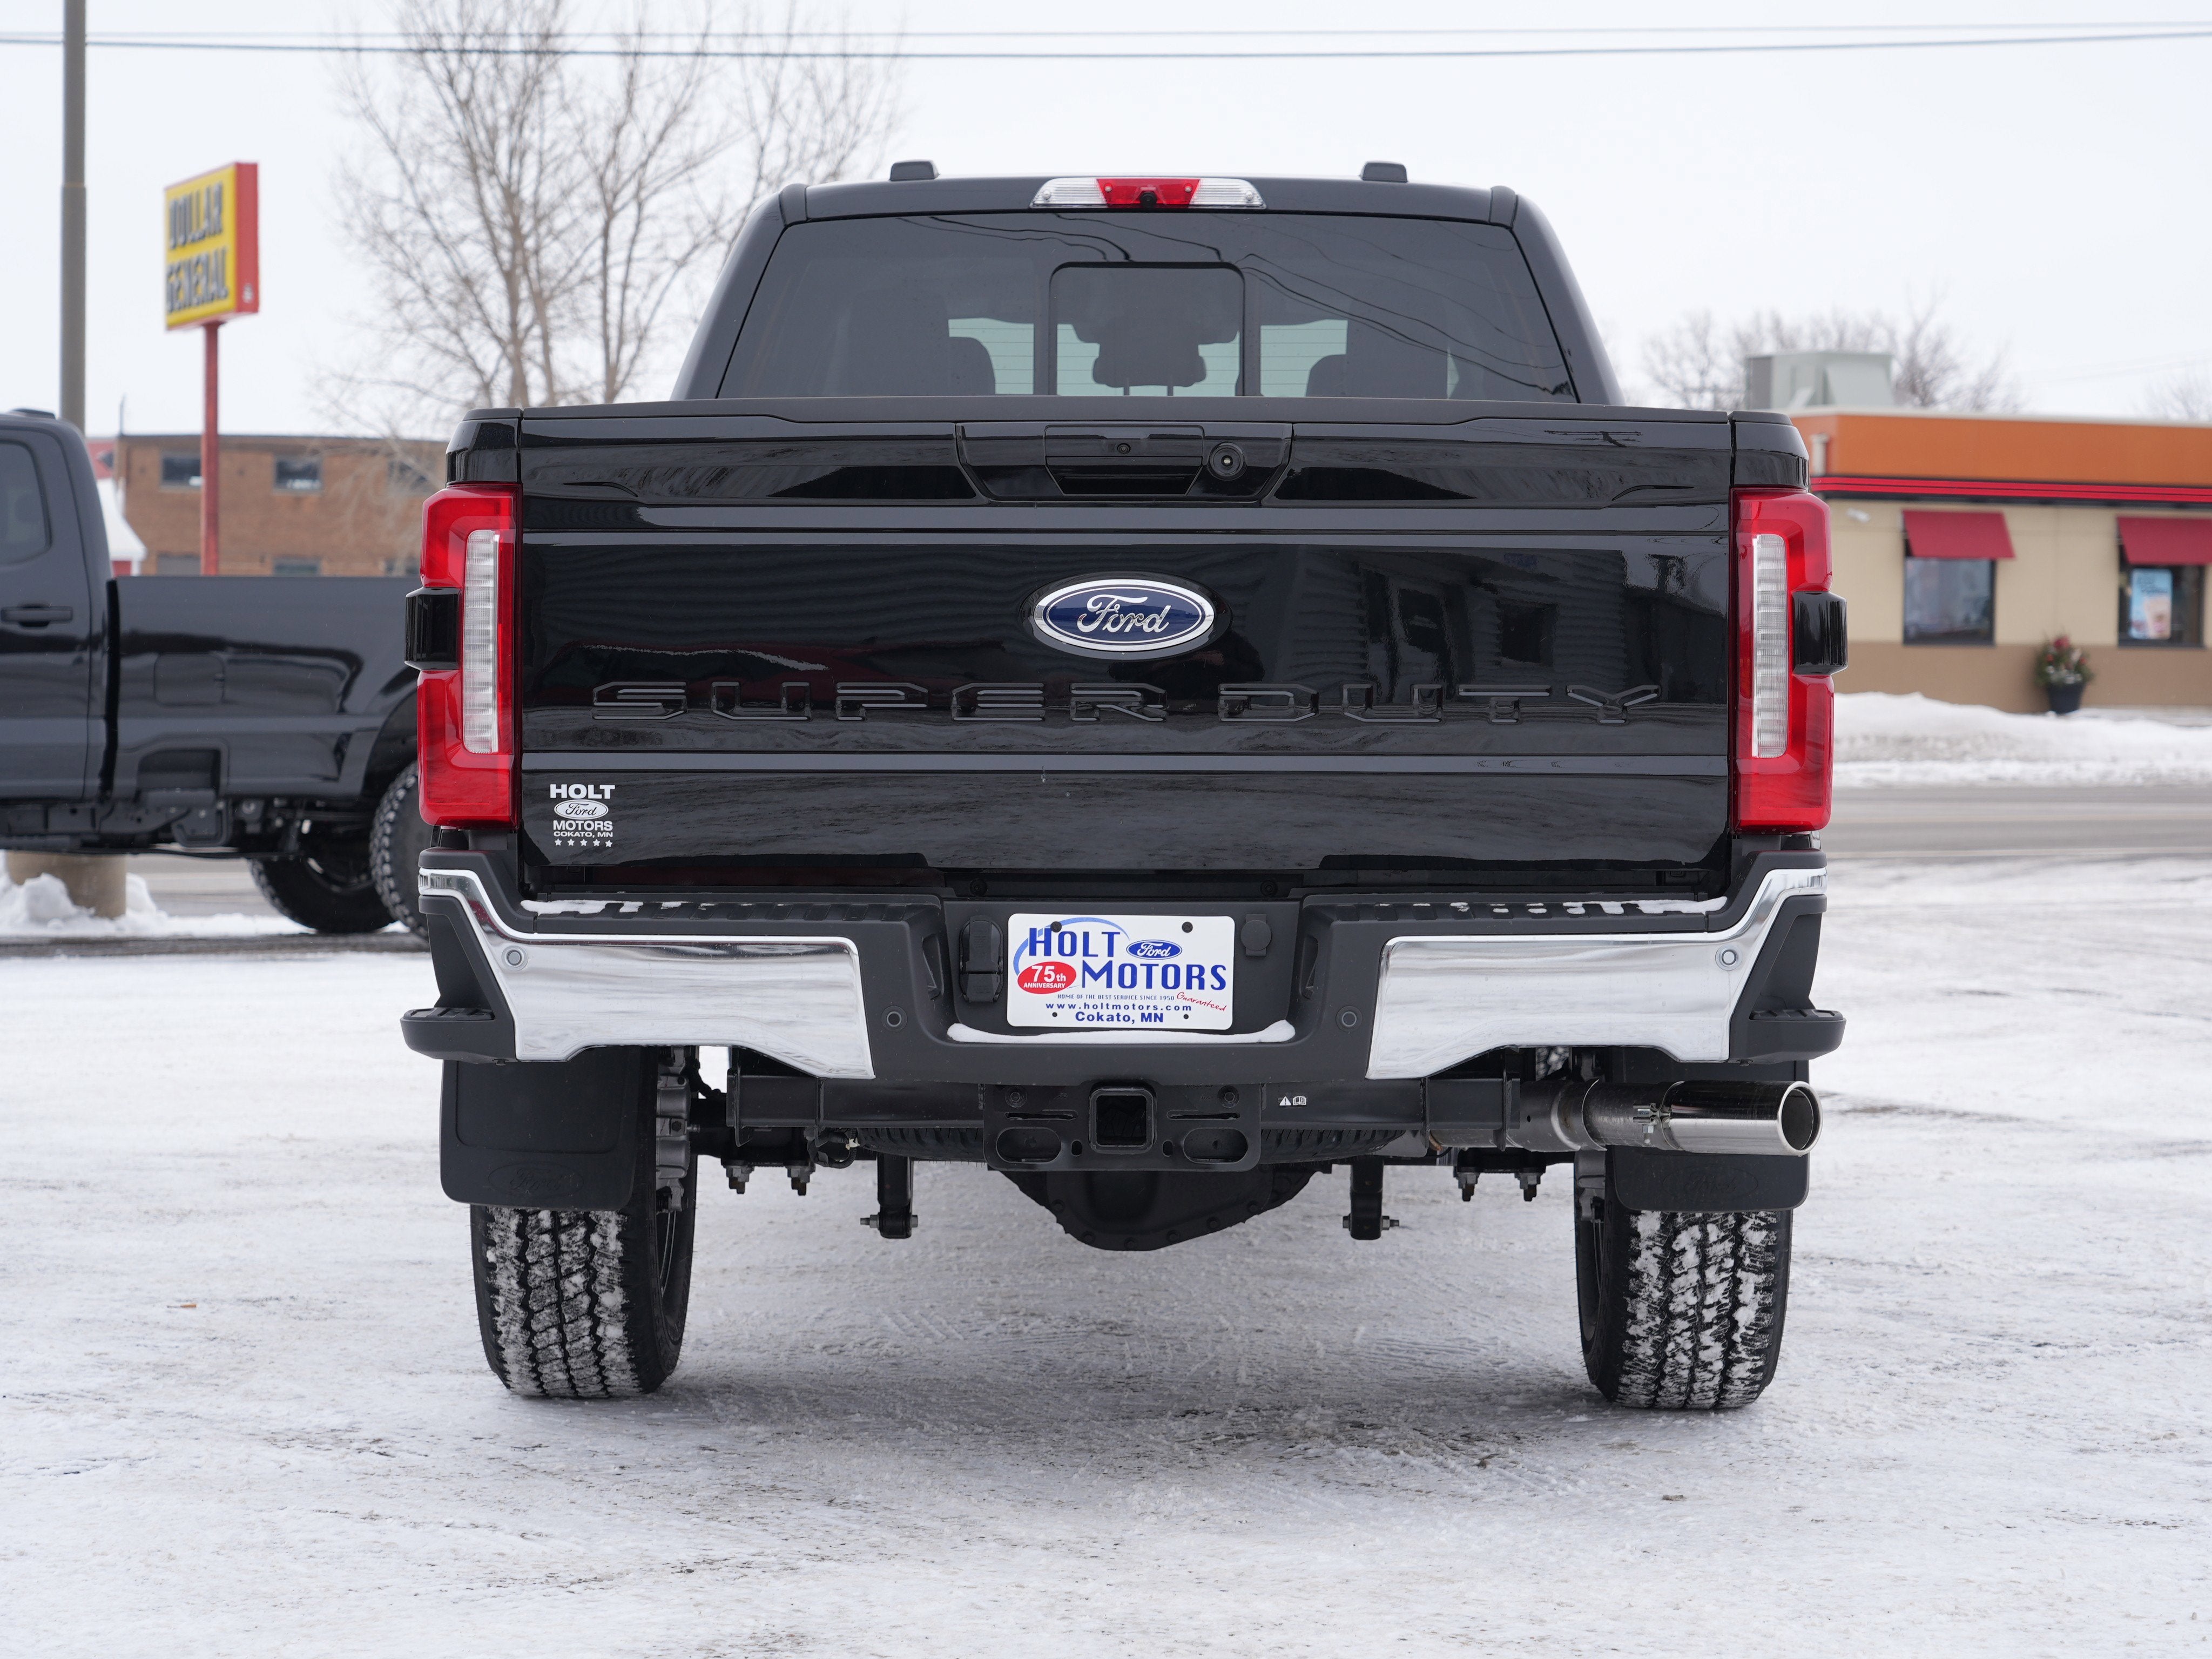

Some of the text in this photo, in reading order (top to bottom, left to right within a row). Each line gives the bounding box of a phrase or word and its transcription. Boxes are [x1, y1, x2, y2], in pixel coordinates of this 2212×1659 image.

[1077, 594, 1171, 633] Ford
[592, 680, 1661, 724] SUPER DUTY
[550, 784, 616, 799] HOLT
[565, 802, 597, 815] Ford
[553, 820, 613, 831] MOTORS
[1029, 927, 1121, 957] HOLT
[1137, 942, 1172, 957] Ford
[1031, 965, 1067, 982] 75th
[1082, 960, 1226, 990] MOTORS
[1046, 1002, 1192, 1011] www.holtmotors.com
[1176, 992, 1227, 1012] Guaranteed
[1075, 1011, 1164, 1024] Cokato, MN
